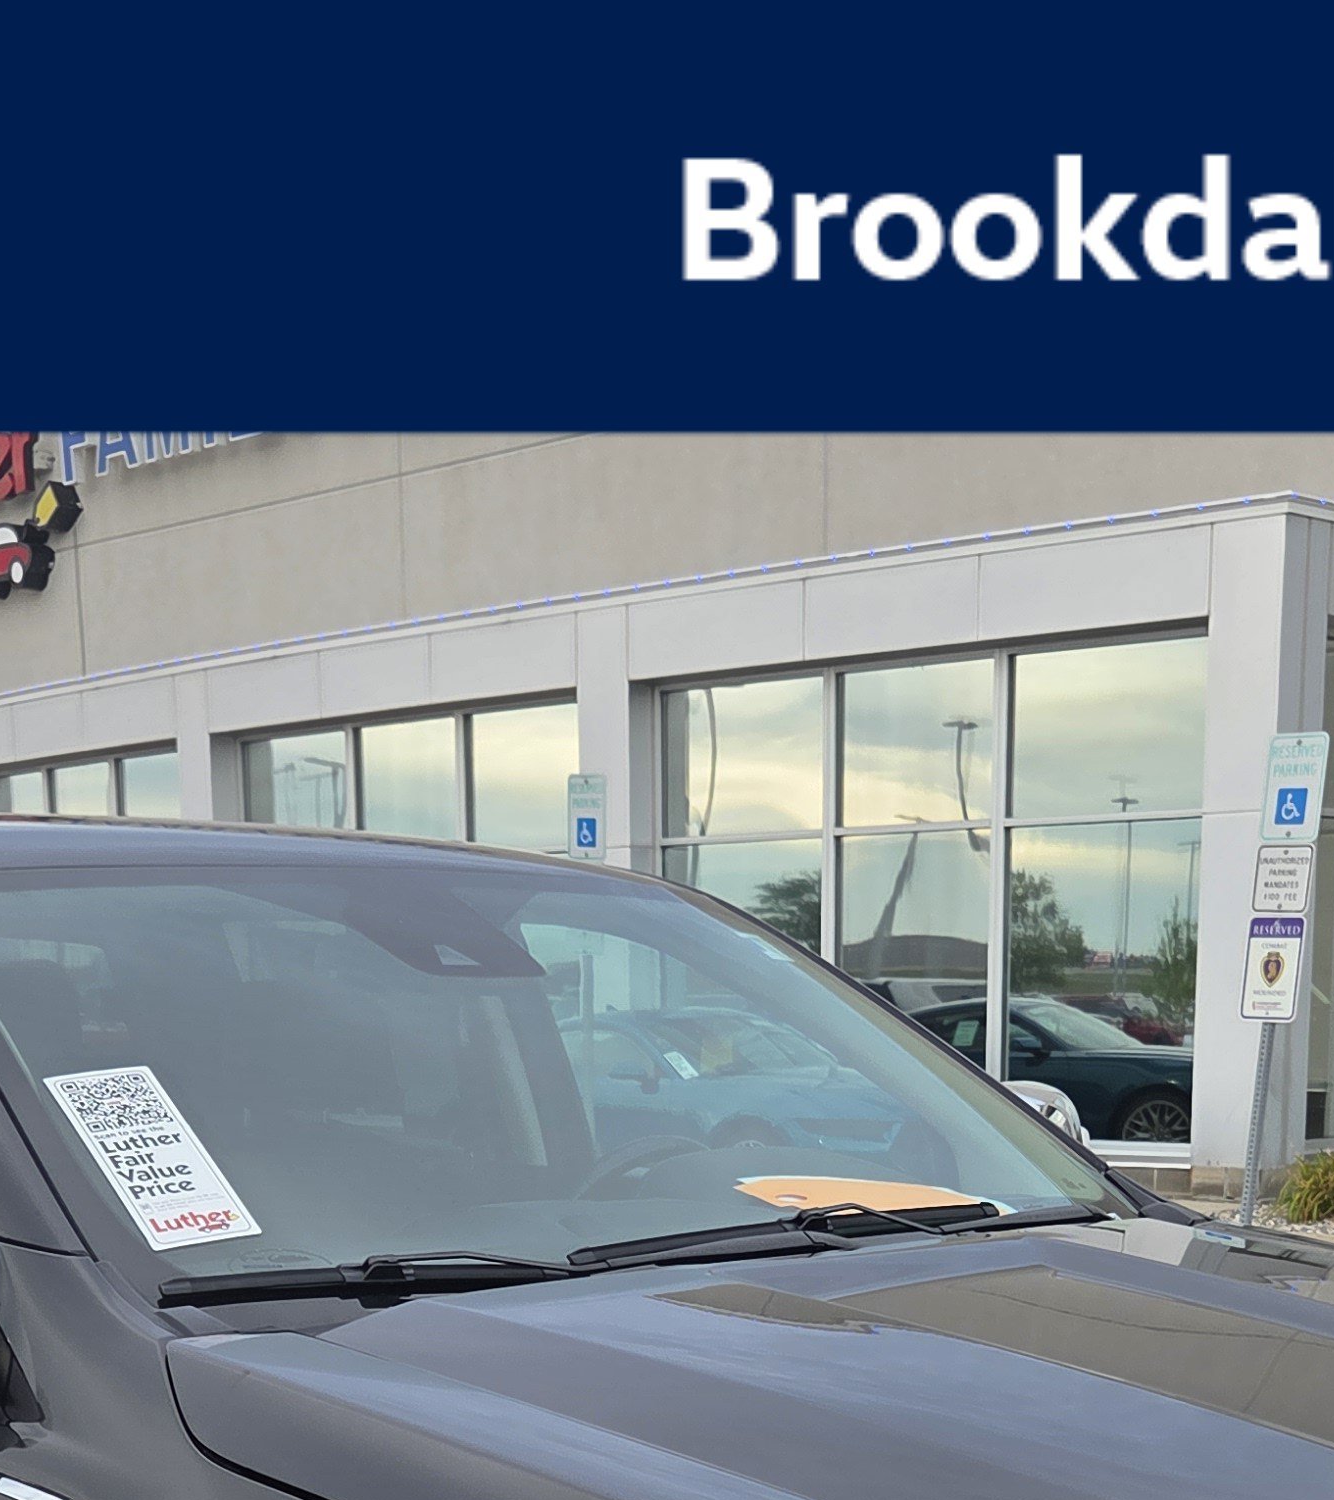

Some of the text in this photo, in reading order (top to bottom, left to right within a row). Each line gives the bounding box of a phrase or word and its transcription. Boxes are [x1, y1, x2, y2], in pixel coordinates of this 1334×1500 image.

[1270, 744, 1323, 760] RESERVED
[1272, 763, 1317, 777] PARKING
[1252, 924, 1301, 936] RESERVED
[98, 1132, 183, 1154] Luther
[108, 1150, 156, 1170] Fair
[116, 1163, 193, 1184] Value
[128, 1180, 197, 1200] Price
[149, 1209, 234, 1234] Luther
